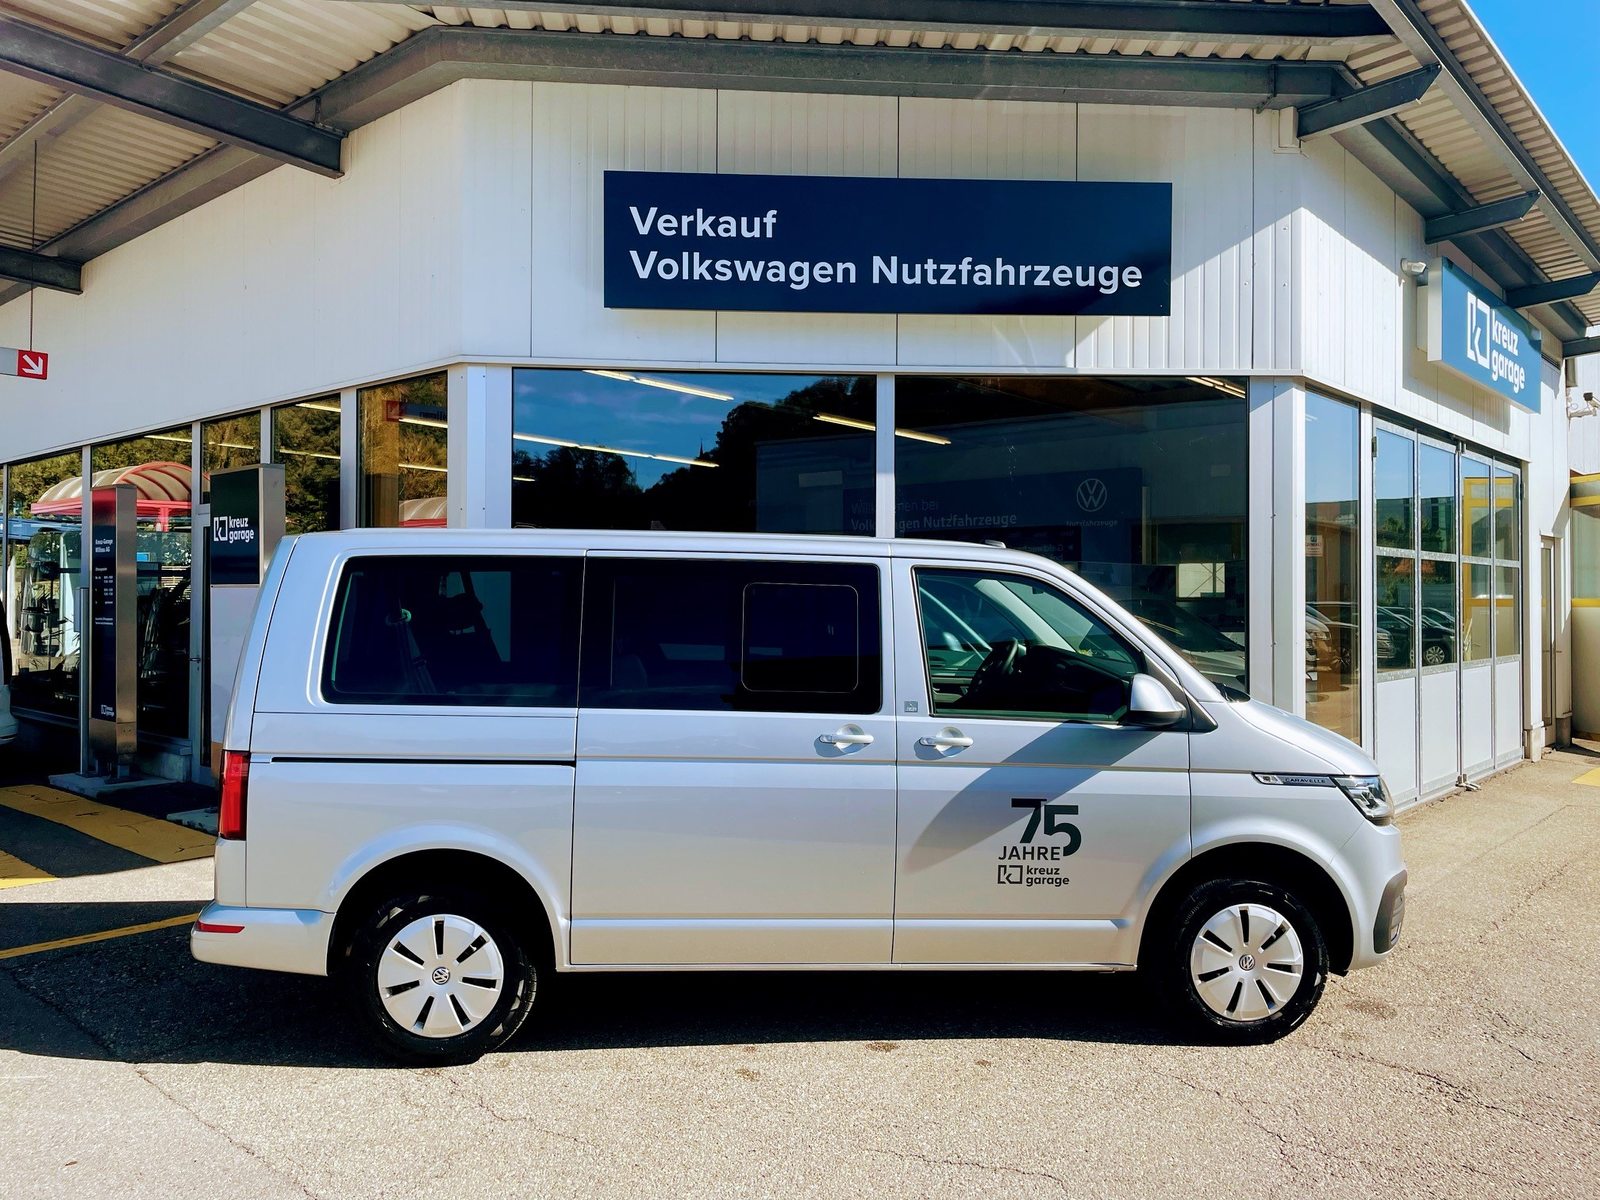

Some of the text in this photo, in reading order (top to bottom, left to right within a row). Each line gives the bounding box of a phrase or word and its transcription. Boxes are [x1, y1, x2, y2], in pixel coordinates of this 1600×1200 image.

[629, 206, 777, 238] Verkauf
[629, 250, 1143, 295] Volkswagen Nutzfahrzeuge
[1492, 310, 1519, 356] kreuz
[1491, 350, 1526, 394] garage
[229, 516, 249, 528] kreuz
[923, 513, 1018, 529] Nutzfahrzeuge
[229, 529, 254, 544] garage
[1010, 798, 1082, 857] 75
[998, 845, 1061, 861] JAHRE
[1026, 865, 1060, 875] kreuz
[1026, 876, 1070, 887] garage
